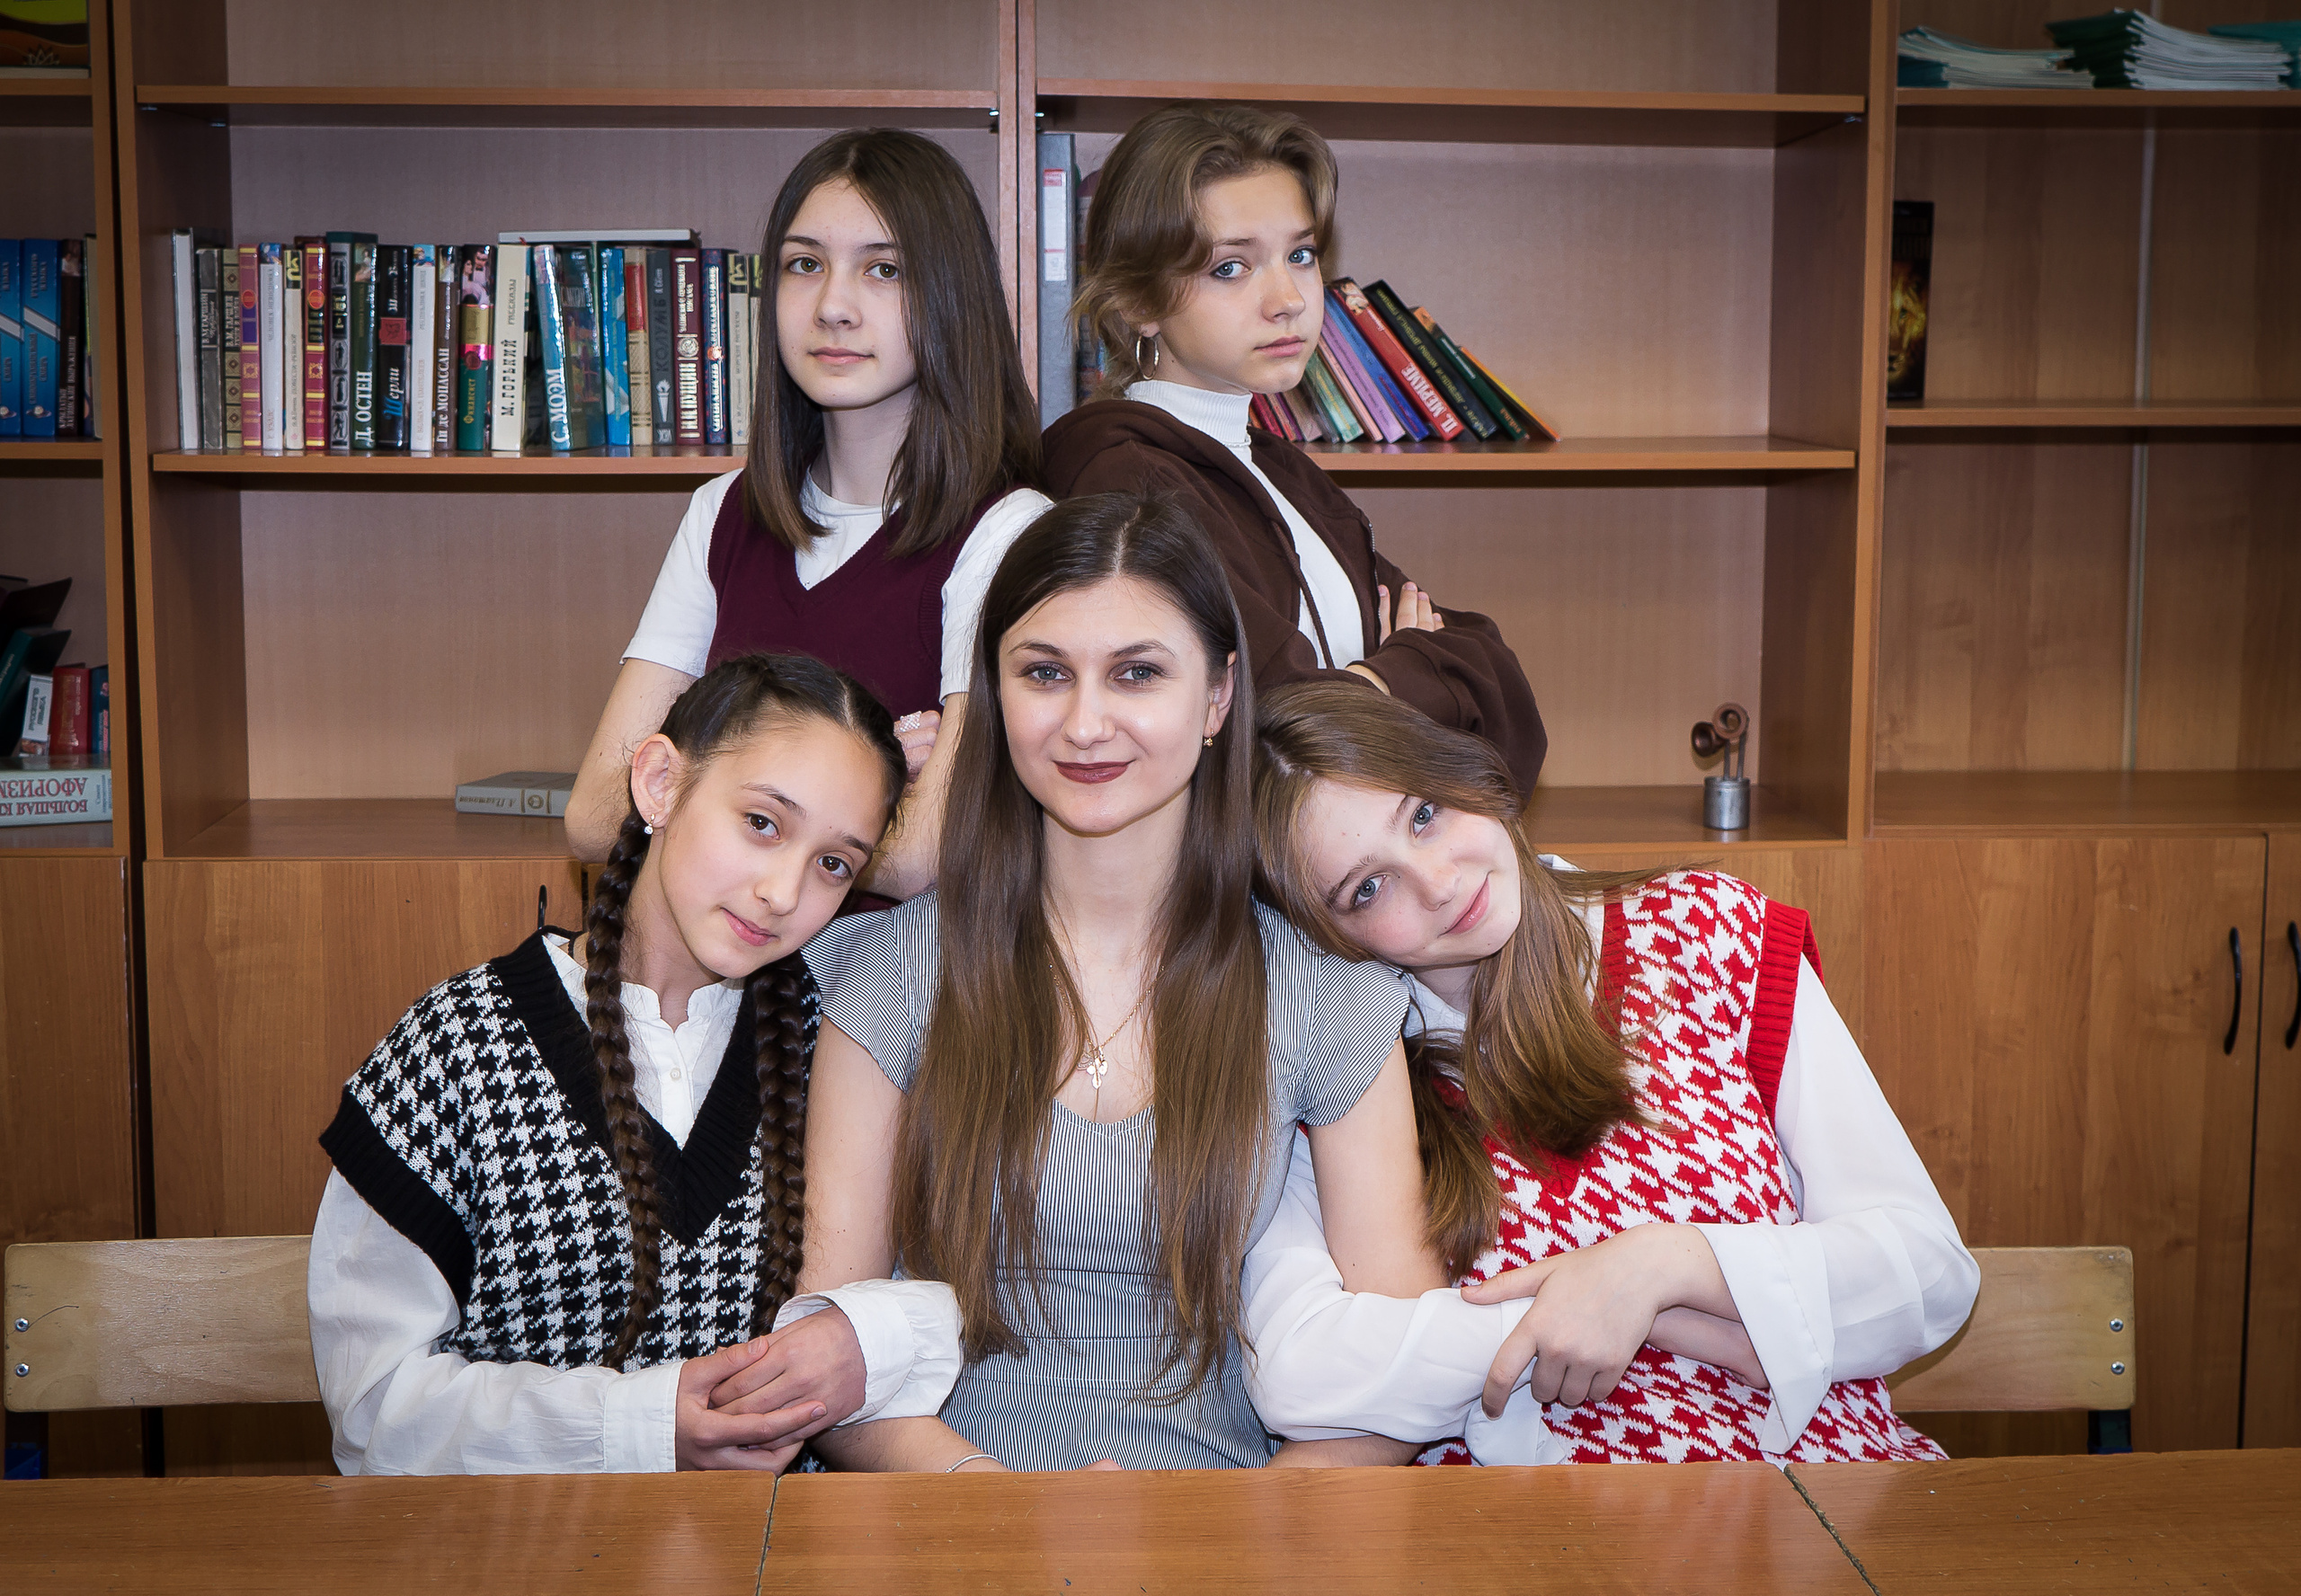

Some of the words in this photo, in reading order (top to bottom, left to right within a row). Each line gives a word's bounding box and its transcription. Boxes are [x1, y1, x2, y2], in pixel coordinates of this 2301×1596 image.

[653, 297, 669, 372] КОЛУМБ
[355, 371, 373, 422] ОСТЕН
[382, 367, 404, 420] Шерли
[438, 348, 450, 411] МОПАССАН
[463, 377, 476, 424] Финансист
[546, 368, 566, 424] МОЭМ
[1399, 361, 1448, 419] МЕРИМЕ
[437, 430, 448, 443] Ги
[439, 414, 449, 428] де
[15, 799, 88, 816] БОЛЬШАЯ
